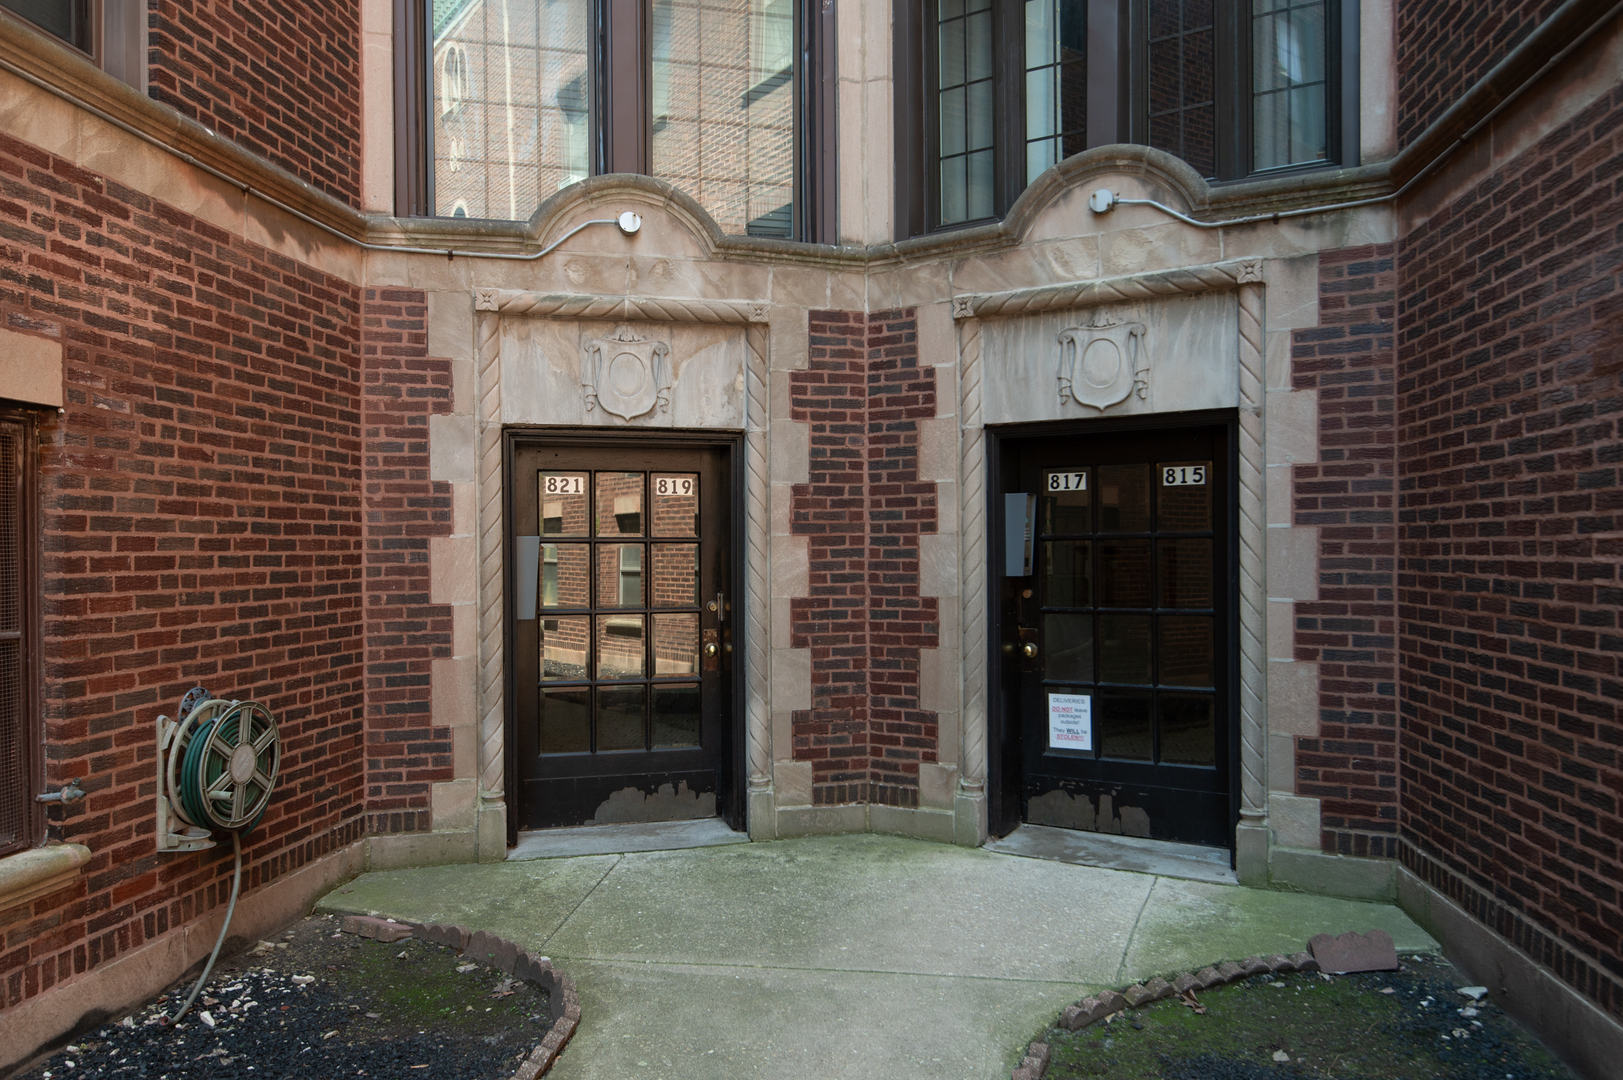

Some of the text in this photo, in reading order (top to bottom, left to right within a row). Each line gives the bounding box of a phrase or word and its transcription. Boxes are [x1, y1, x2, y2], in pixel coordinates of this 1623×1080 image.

[1050, 474, 1084, 489] 817
[1165, 467, 1203, 484] 815
[547, 478, 580, 493] 821
[658, 480, 691, 494] 819
